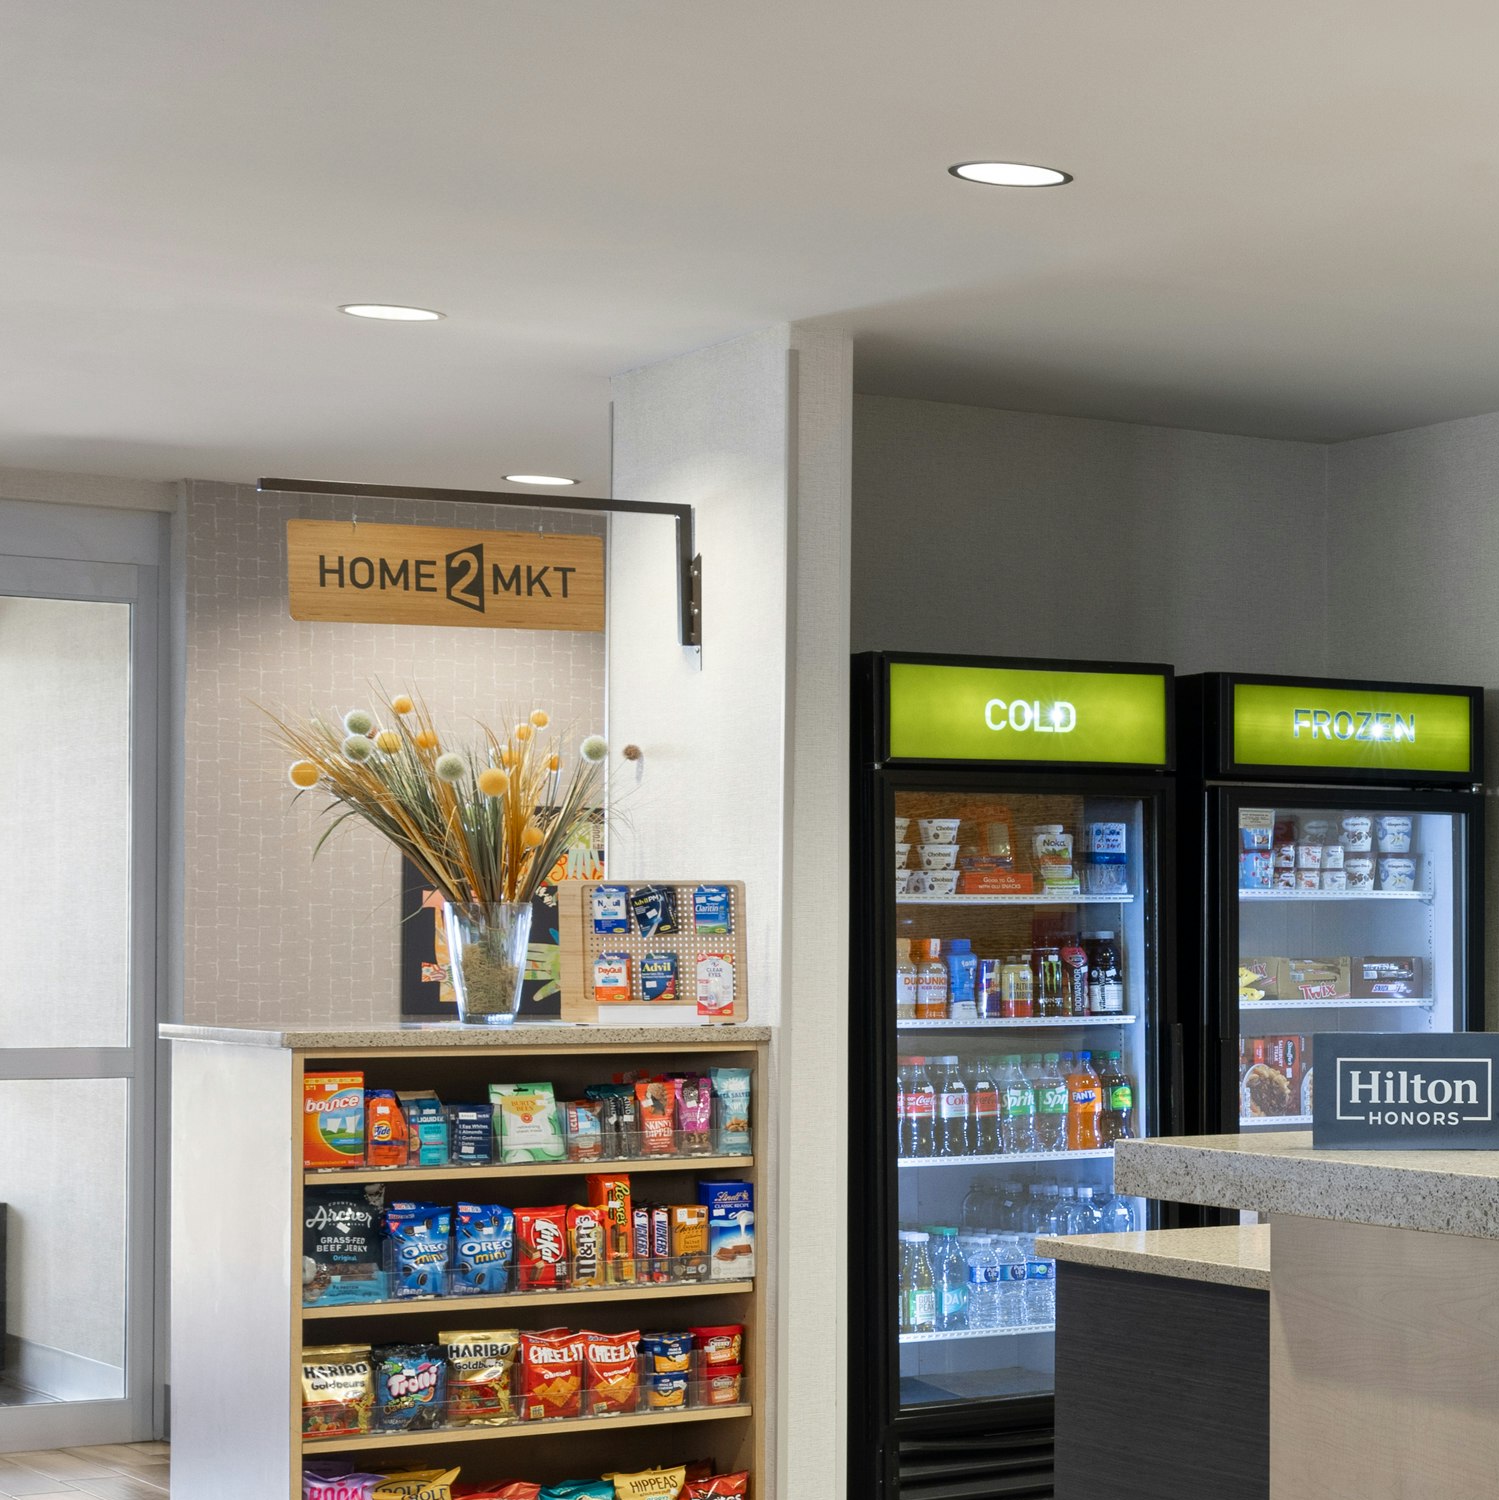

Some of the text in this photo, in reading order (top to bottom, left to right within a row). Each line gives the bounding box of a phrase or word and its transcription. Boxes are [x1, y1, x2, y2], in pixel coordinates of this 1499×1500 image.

[319, 554, 438, 593] HOME
[492, 563, 576, 599] MKT
[984, 698, 1077, 733] COLD
[1293, 708, 1416, 743] FROZEN
[695, 904, 719, 913] Claritin
[598, 967, 622, 976] DayQuil
[642, 963, 672, 972] Advil
[1073, 968, 1082, 1012] BODYARMOR
[1349, 1070, 1479, 1105] Hilton
[1369, 1111, 1460, 1126] HONORS
[374, 1124, 391, 1137] Tide
[305, 1205, 373, 1231] Archer
[320, 1236, 366, 1245] GRASS-FED
[635, 1212, 648, 1257] SICKERS
[316, 1244, 368, 1253] BEEF JERKY
[403, 1243, 448, 1259] OREO
[461, 1240, 512, 1256] OREO
[332, 1254, 358, 1262] Original
[415, 1252, 444, 1265] mini
[475, 1250, 507, 1265] mini
[448, 1343, 512, 1359] HARIBO
[304, 1363, 368, 1379] HARIBO
[311, 1380, 365, 1391] Goldbears
[388, 1365, 438, 1397] Trolli
[630, 1475, 678, 1494] HIPPEAS
